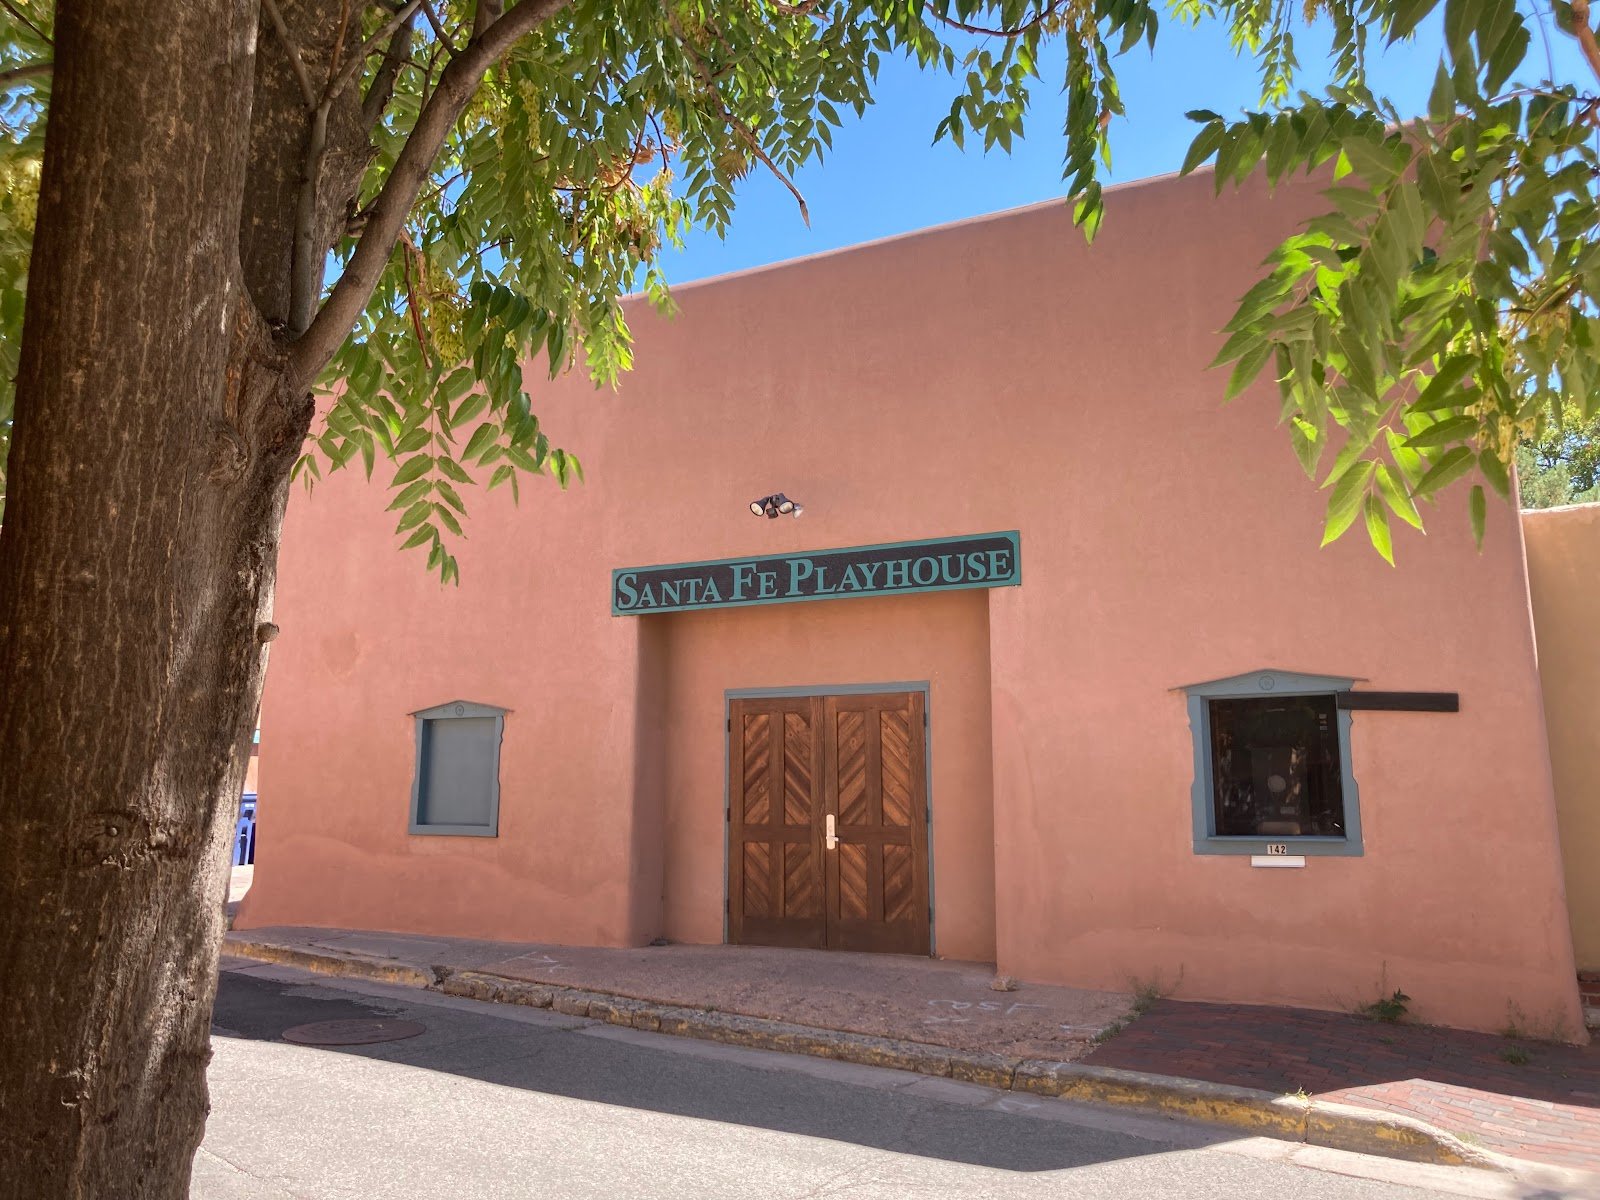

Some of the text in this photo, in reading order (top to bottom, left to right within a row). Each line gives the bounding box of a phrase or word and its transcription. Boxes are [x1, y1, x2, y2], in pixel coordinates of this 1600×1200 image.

[616, 549, 1013, 610] SANTA FE PLAYHOUSE
[1269, 845, 1286, 855] 142
